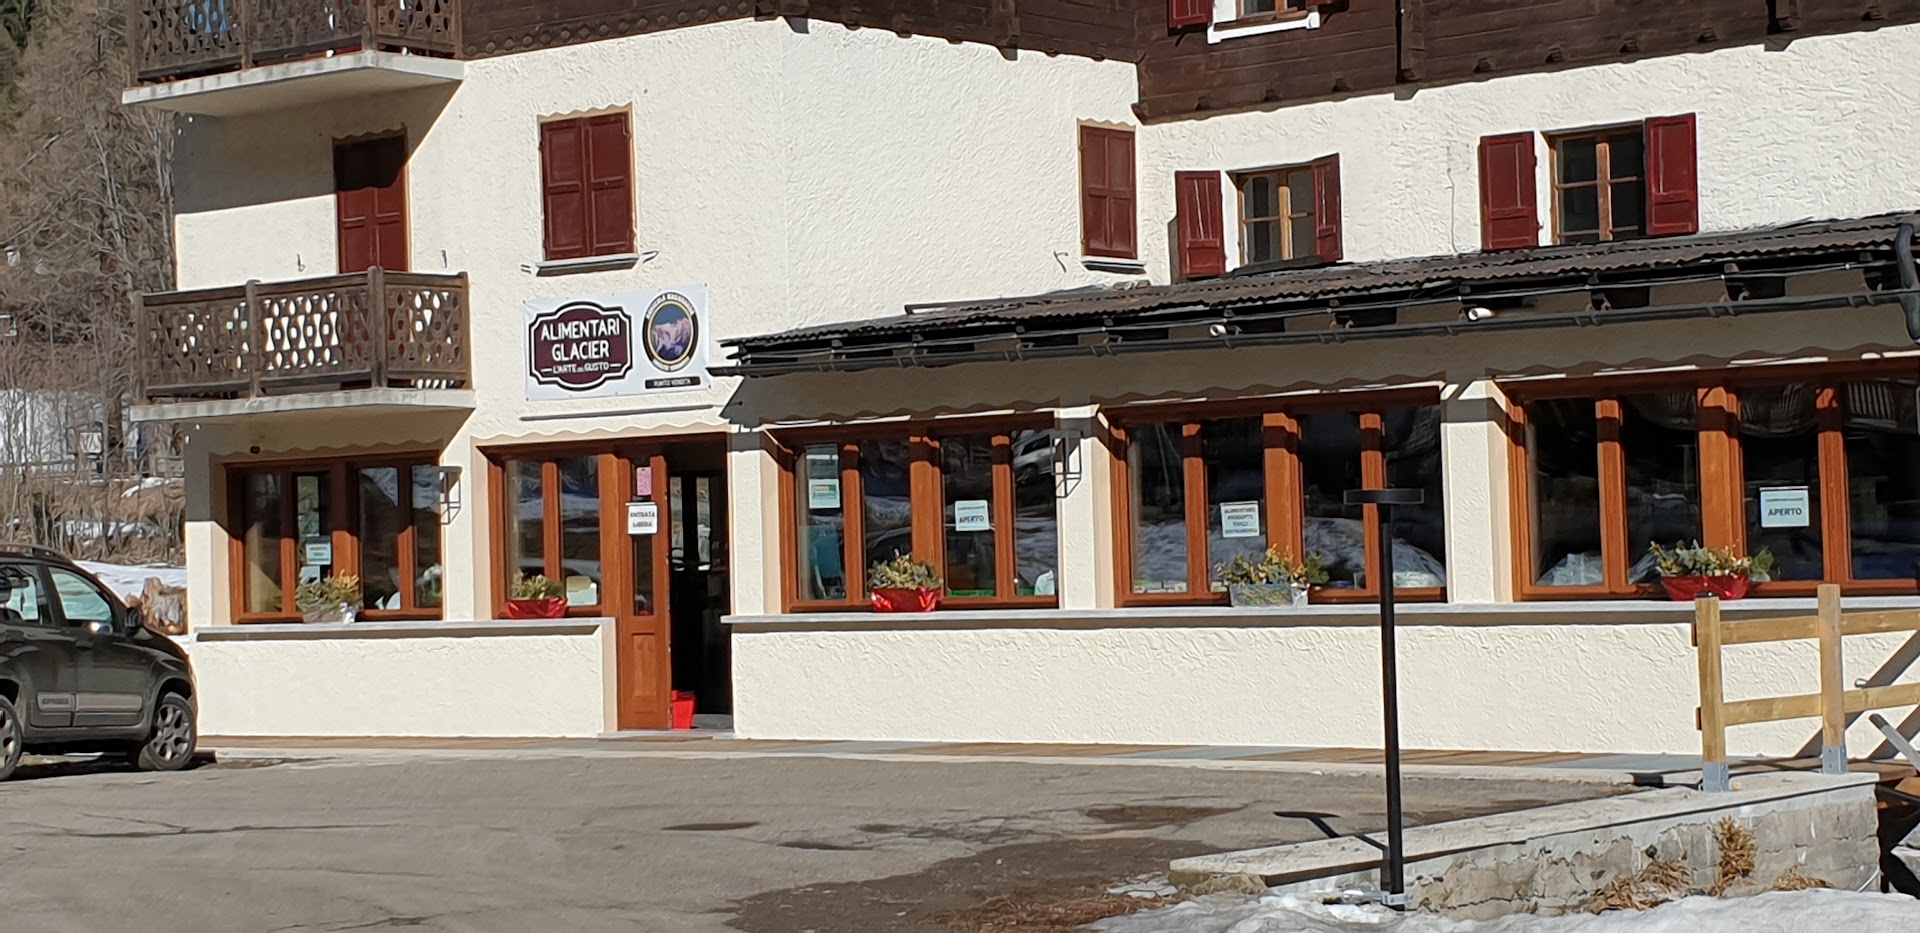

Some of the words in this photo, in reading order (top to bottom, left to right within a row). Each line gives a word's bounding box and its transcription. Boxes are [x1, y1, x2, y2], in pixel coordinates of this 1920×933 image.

[541, 318, 620, 341] ALIMENTARI
[552, 340, 609, 362] GLACIER
[553, 364, 577, 374] L'ARTE
[584, 361, 609, 371] GUSTO
[1768, 507, 1802, 516] APERTO
